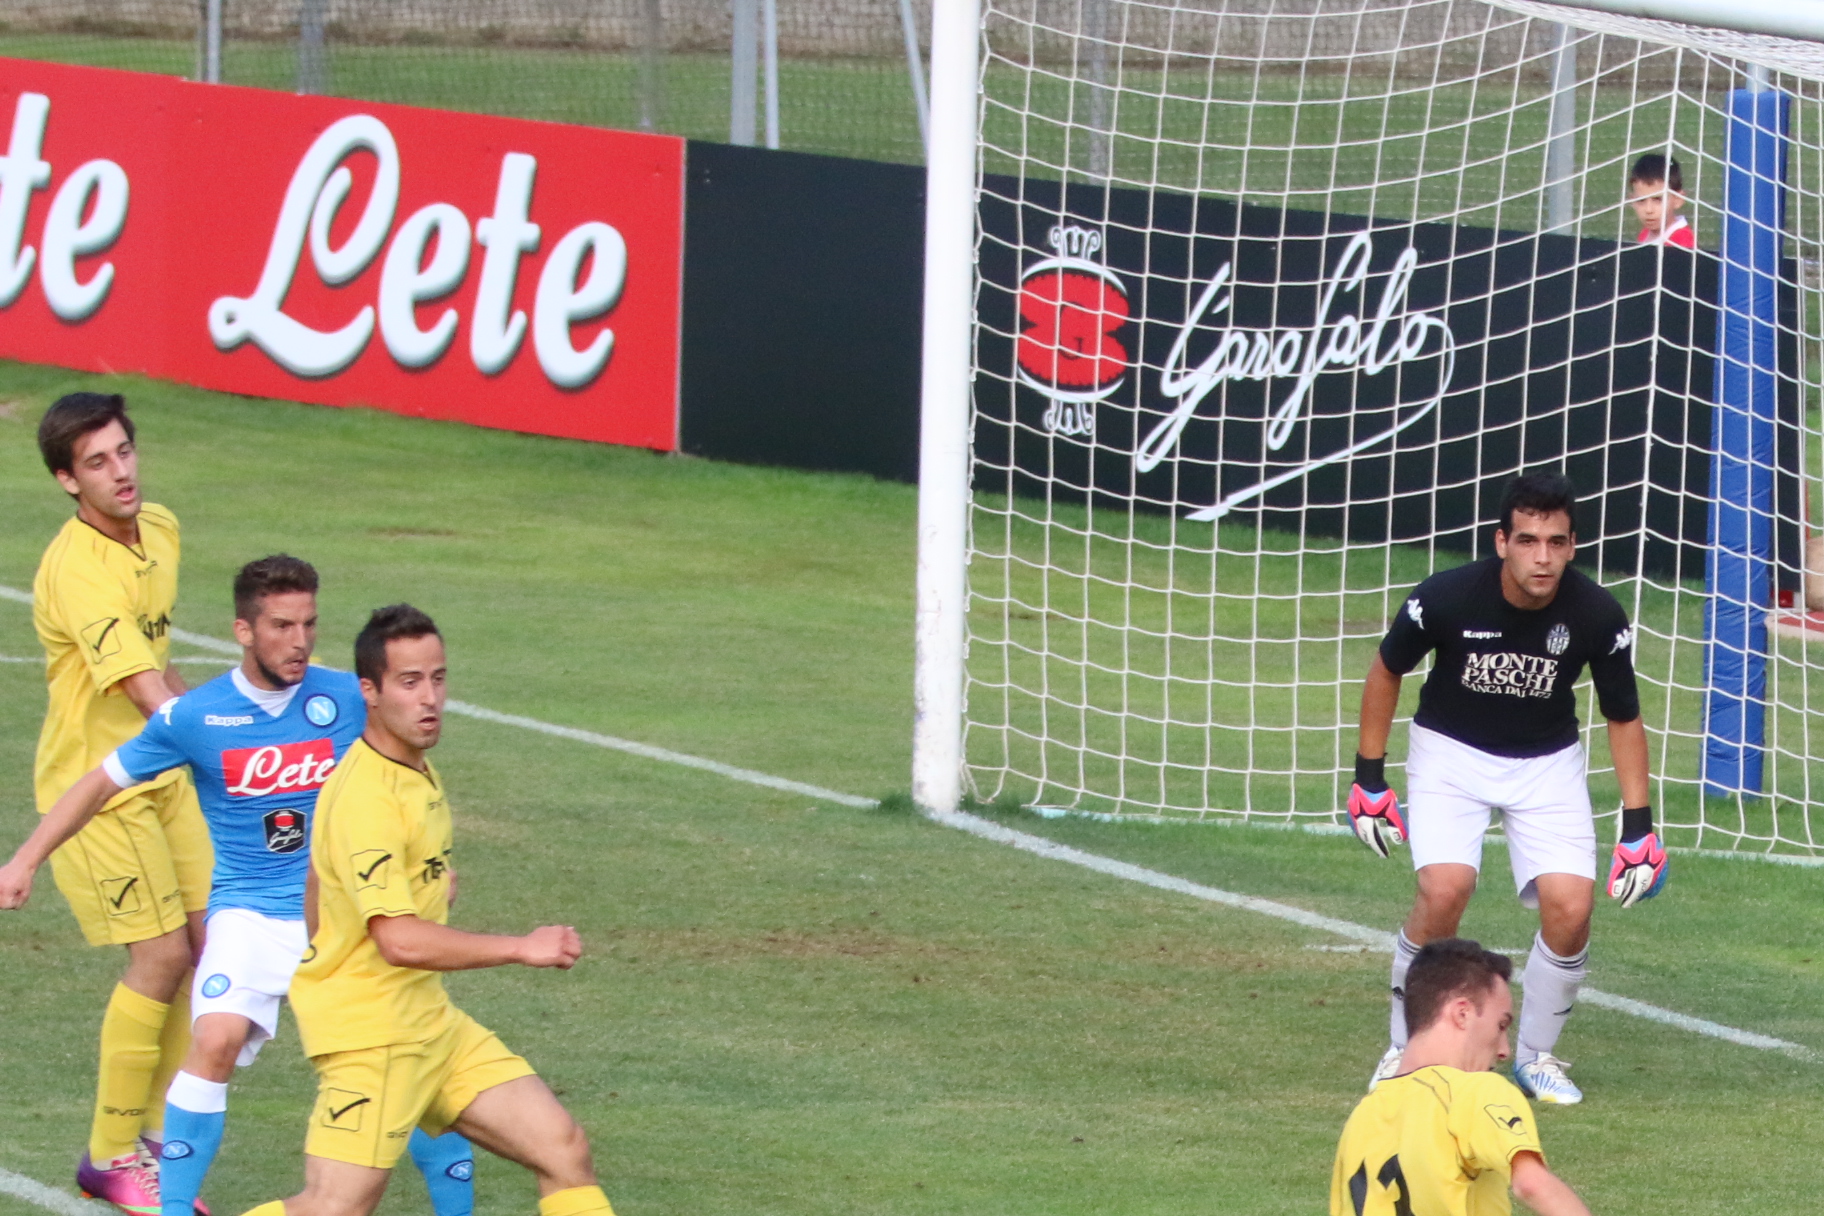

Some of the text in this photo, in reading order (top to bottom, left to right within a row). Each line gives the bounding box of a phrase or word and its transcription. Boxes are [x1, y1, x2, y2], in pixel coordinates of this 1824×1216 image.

[208, 114, 628, 389] Lete
[1136, 231, 1455, 521] Garofalo
[1467, 652, 1558, 677] MONTE
[1461, 665, 1556, 693] PASCHI
[205, 716, 253, 725] Kappa
[311, 701, 330, 720] N
[227, 746, 336, 796] Lete
